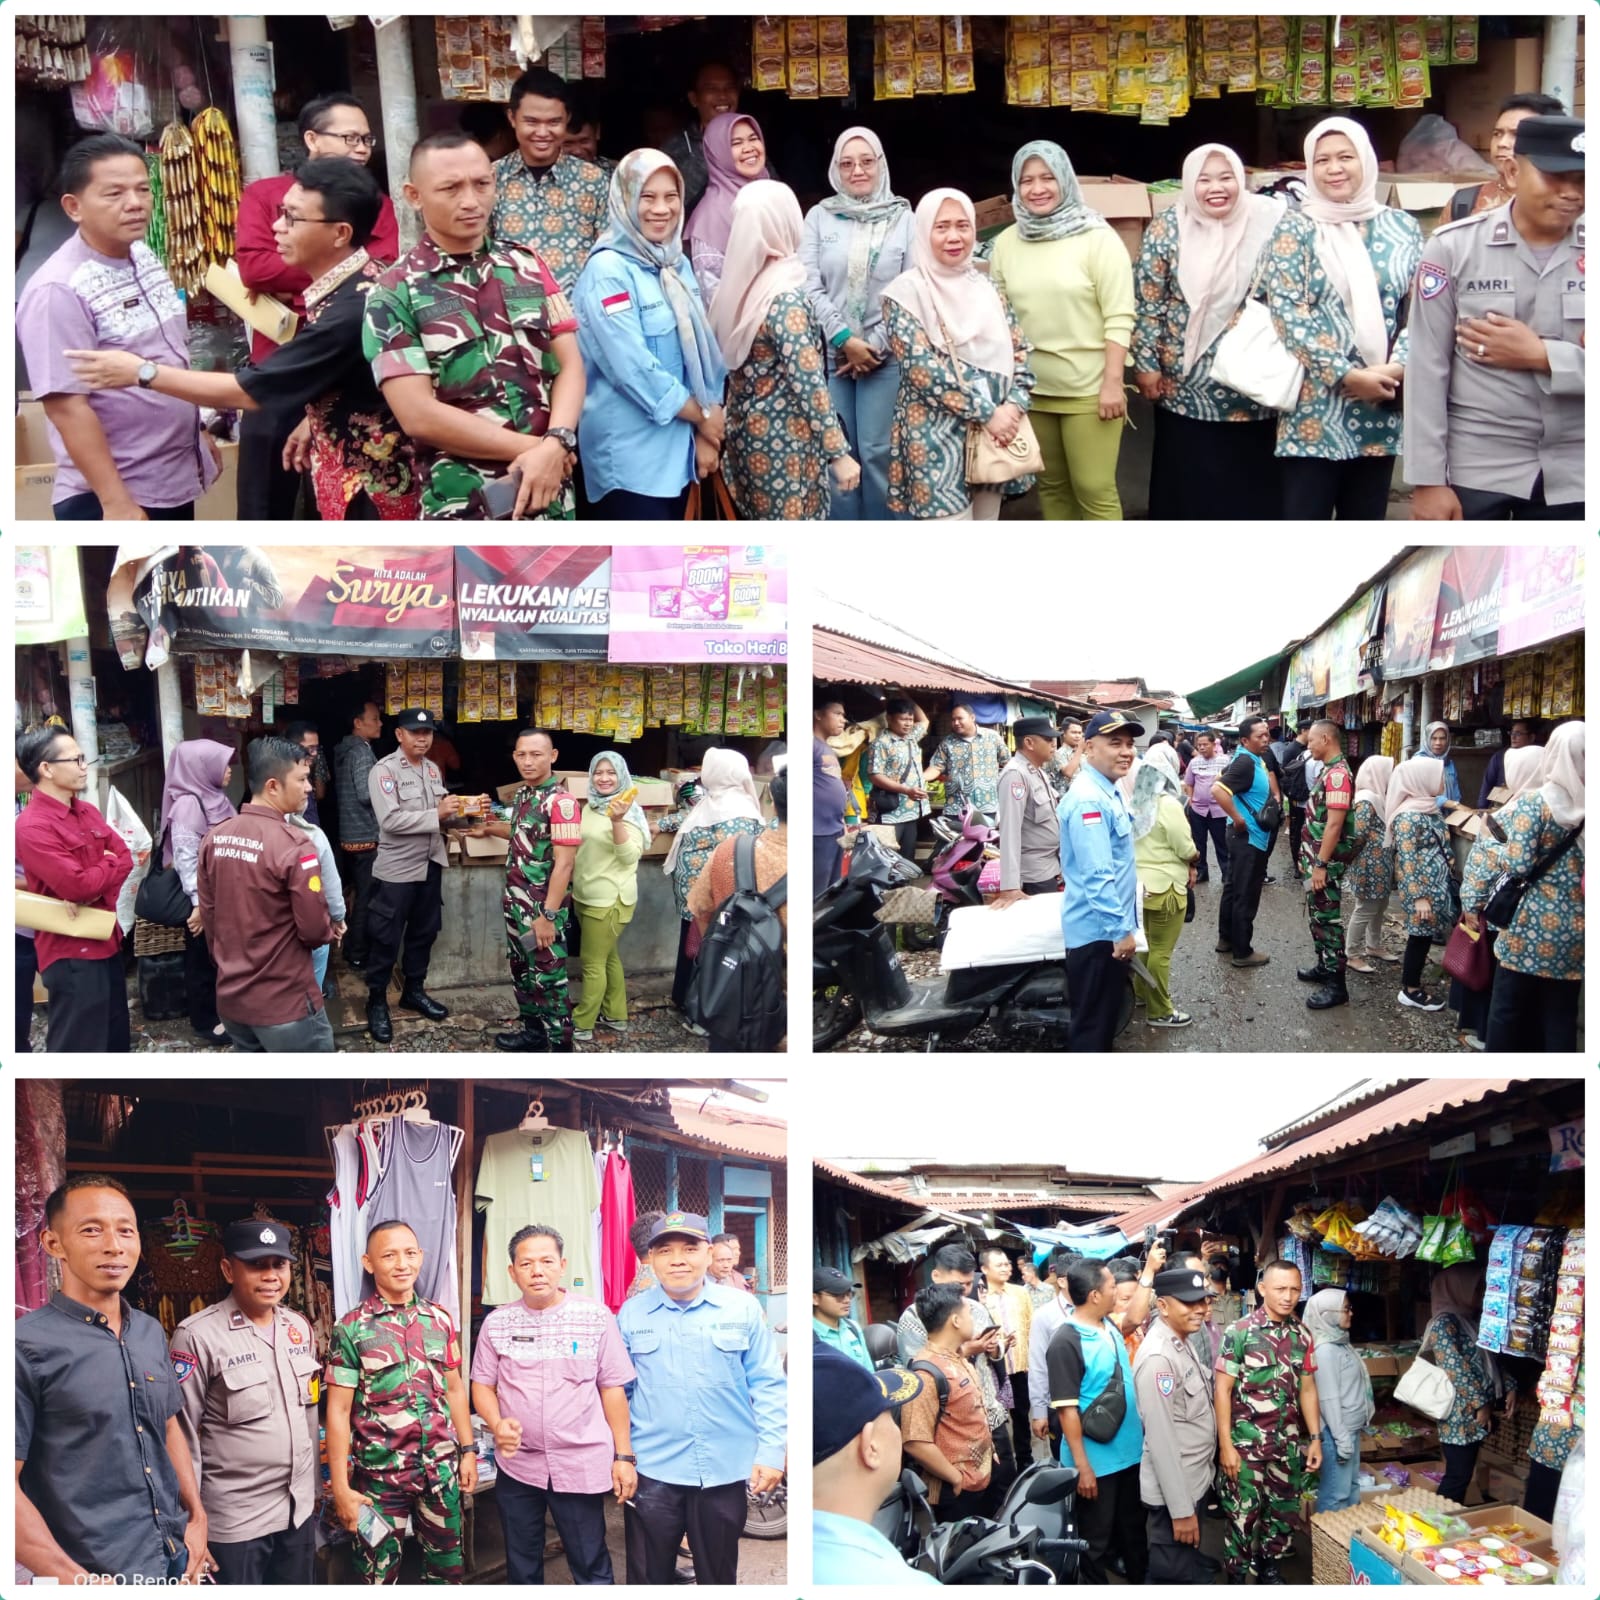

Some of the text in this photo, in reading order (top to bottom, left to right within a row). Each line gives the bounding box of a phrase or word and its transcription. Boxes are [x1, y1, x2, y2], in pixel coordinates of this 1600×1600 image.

[1466, 279, 1508, 291] AMRI
[374, 568, 426, 581] KITA ADALAH
[688, 567, 724, 587] BOOM
[326, 565, 448, 623] Surya
[460, 582, 569, 607] LEKUKAN
[734, 585, 760, 603] BOOM
[461, 607, 608, 624] NYALAKAN KUALITAS
[704, 639, 744, 655] Toko
[747, 639, 777, 655] Heri
[213, 835, 263, 852] HORTIKULTURA
[214, 847, 240, 859] MUARA
[289, 1346, 309, 1356] POLRI
[227, 1352, 257, 1368] AMRI
